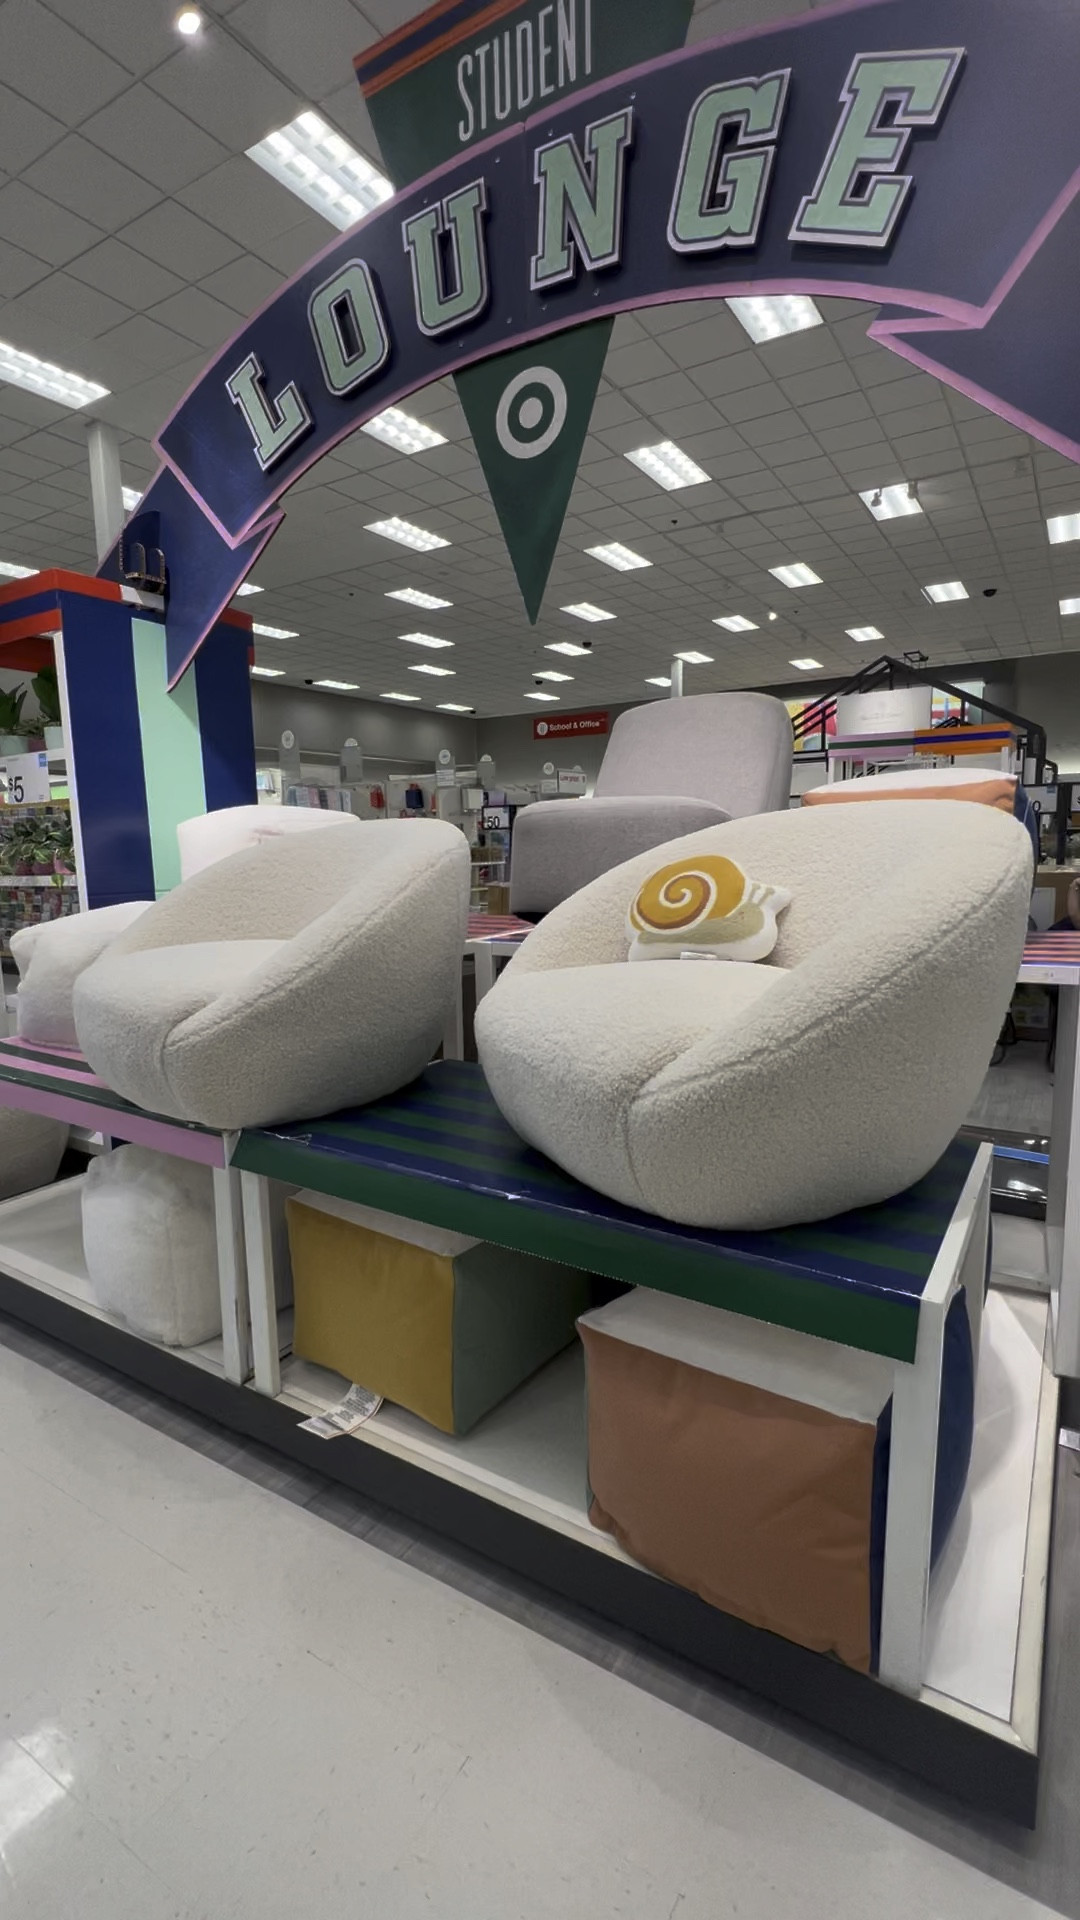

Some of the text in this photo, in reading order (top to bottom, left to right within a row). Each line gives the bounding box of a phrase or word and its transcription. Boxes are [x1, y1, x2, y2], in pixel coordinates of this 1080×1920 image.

[457, 0, 592, 142] STUDENT
[225, 47, 965, 472] LOUNGE
[549, 722, 572, 732] School
[579, 720, 600, 729] Office
[8, 775, 25, 803] $5
